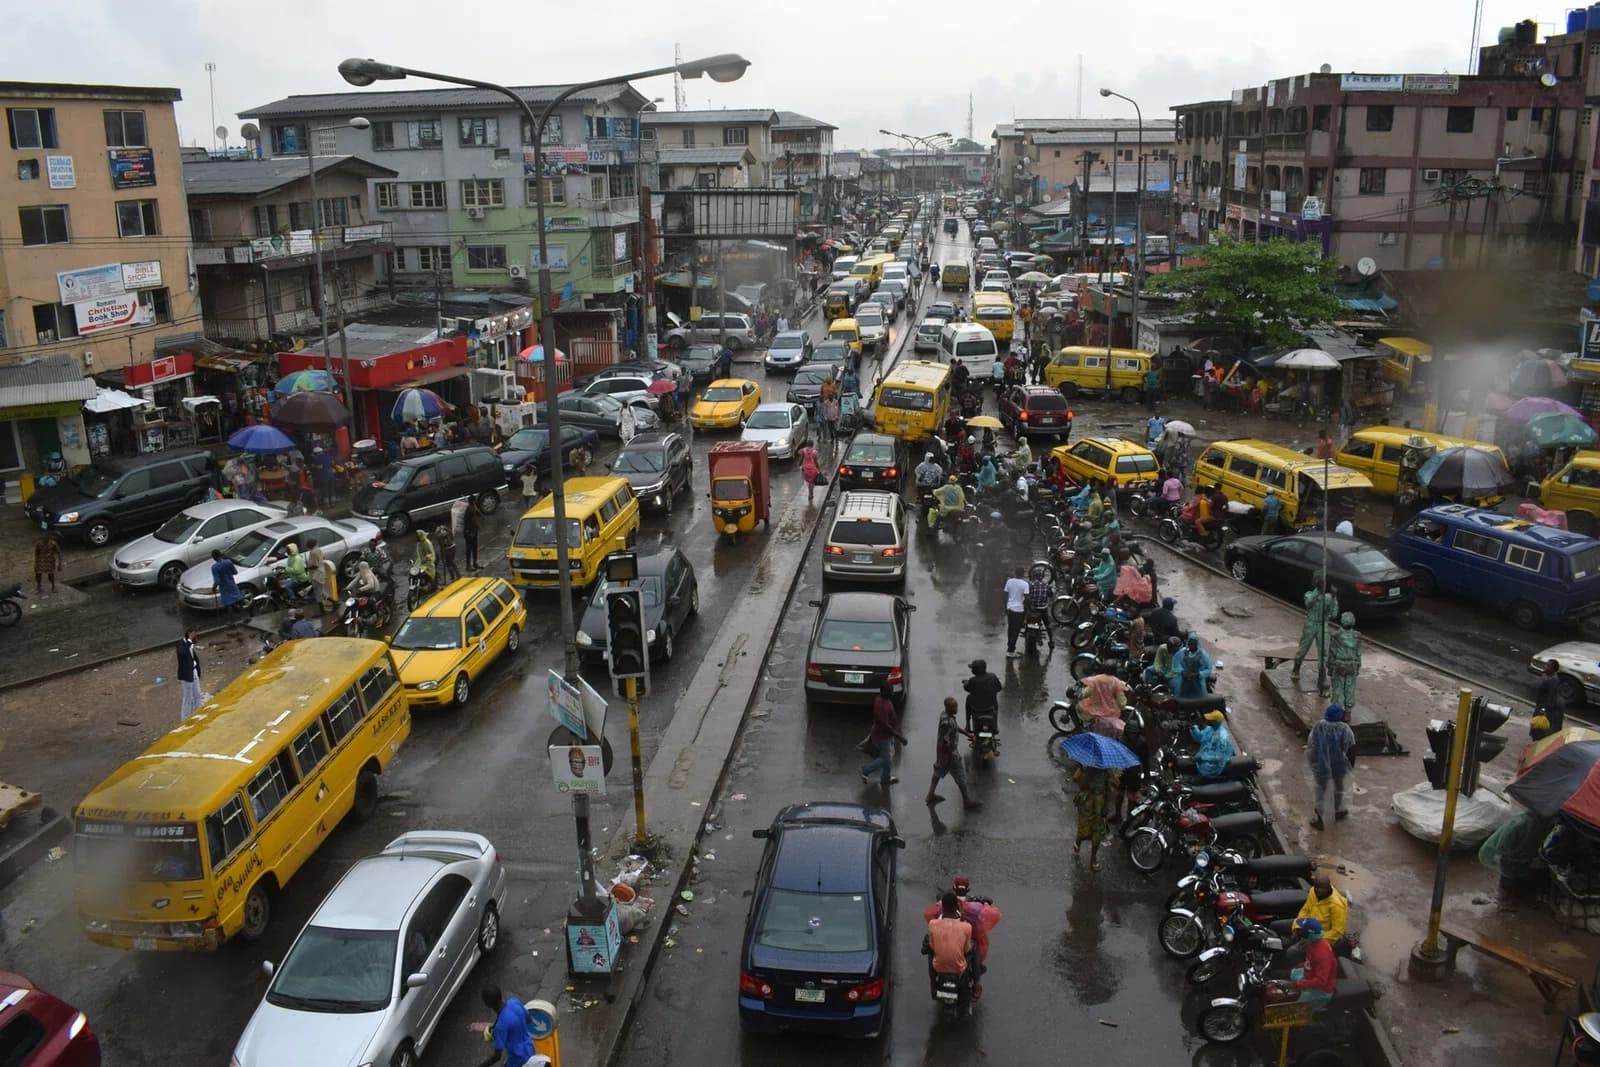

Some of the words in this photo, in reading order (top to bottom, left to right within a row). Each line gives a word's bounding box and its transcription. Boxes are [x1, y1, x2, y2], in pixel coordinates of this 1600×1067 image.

[88, 304, 128, 316] Christian
[88, 314, 108, 323] Book
[110, 309, 129, 319] Shop
